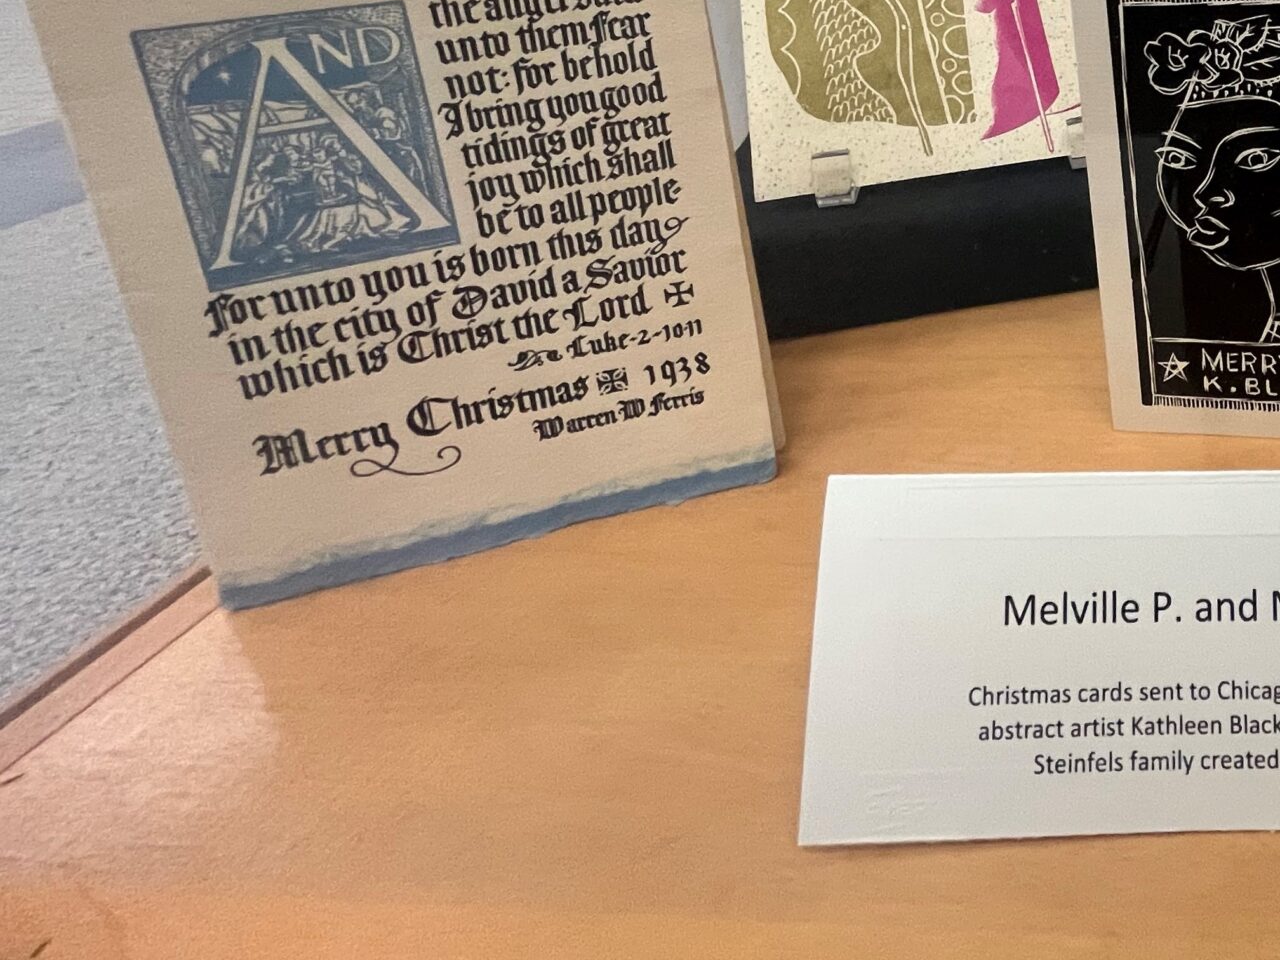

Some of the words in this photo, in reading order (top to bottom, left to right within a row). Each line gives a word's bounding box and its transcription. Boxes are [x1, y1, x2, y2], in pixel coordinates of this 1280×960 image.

[435, 31, 511, 64] unto
[515, 18, 591, 55] them
[561, 38, 658, 82] behold
[464, 98, 546, 133] bring
[547, 88, 601, 127] you
[599, 72, 668, 119] good
[461, 129, 567, 169] tidings
[570, 117, 602, 150] of
[600, 111, 672, 156] great
[465, 172, 520, 210] joy
[519, 151, 605, 194] which
[605, 139, 678, 181] shall
[475, 204, 513, 239] be
[514, 202, 545, 229] to
[550, 190, 589, 227] all
[267, 276, 356, 316] unto
[360, 261, 431, 306] you
[431, 250, 466, 284] is
[469, 239, 544, 277] born
[546, 226, 603, 261] this
[610, 215, 690, 255] day
[228, 333, 271, 365] in
[270, 319, 330, 355] the
[333, 306, 403, 345] city
[406, 290, 446, 329] of
[452, 264, 558, 320] David
[561, 269, 583, 295] a
[583, 247, 688, 293] Savior
[236, 346, 355, 400] which
[356, 341, 388, 376] is
[397, 318, 510, 364] Christ
[511, 306, 560, 340] the
[562, 282, 653, 332] Lord
[1203, 375, 1237, 393] K.
[252, 422, 399, 477] Merry
[406, 375, 590, 437] Christmas
[643, 351, 711, 388] 1938
[531, 409, 619, 441] Warren
[1003, 589, 1140, 627] Melville
[1153, 591, 1182, 624] P.
[1194, 588, 1258, 623] and
[968, 684, 1072, 707] Christmas
[1077, 680, 1133, 703] cards
[1139, 682, 1184, 702] sent
[1188, 682, 1211, 702] to
[978, 719, 1065, 742] abstract
[1070, 716, 1125, 738] artist
[1131, 713, 1223, 737] Kathleen
[1033, 750, 1124, 776] Steinfels
[1128, 748, 1195, 776] family
[1200, 747, 1280, 771] created
